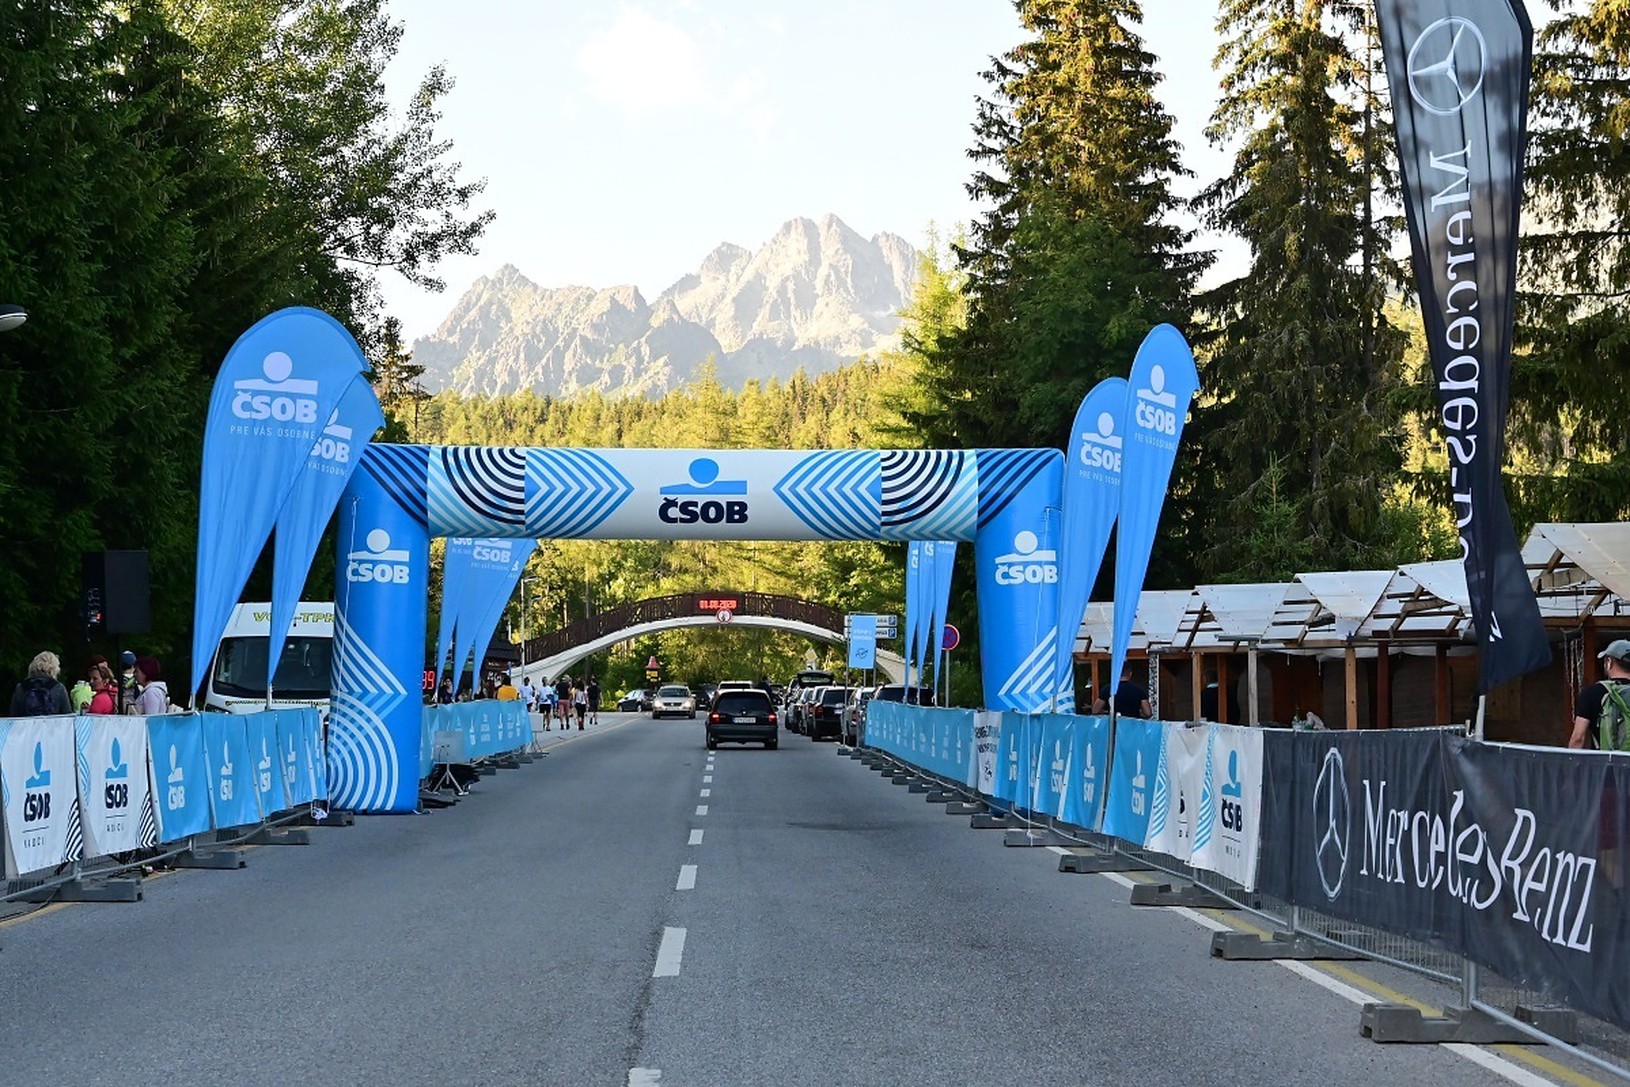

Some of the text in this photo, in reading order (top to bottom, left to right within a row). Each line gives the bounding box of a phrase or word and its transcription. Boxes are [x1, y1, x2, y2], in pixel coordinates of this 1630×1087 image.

[232, 391, 317, 424] ČSOB
[1136, 399, 1176, 435] ČSOB
[230, 425, 249, 436] PRE
[253, 425, 273, 437] VÁS
[310, 437, 350, 463] SOB
[658, 497, 748, 524] ČSOB
[473, 546, 511, 563] ČSOB
[346, 560, 410, 584] ČSOB
[995, 564, 1058, 585] ČSOB
[105, 781, 128, 809] SOB
